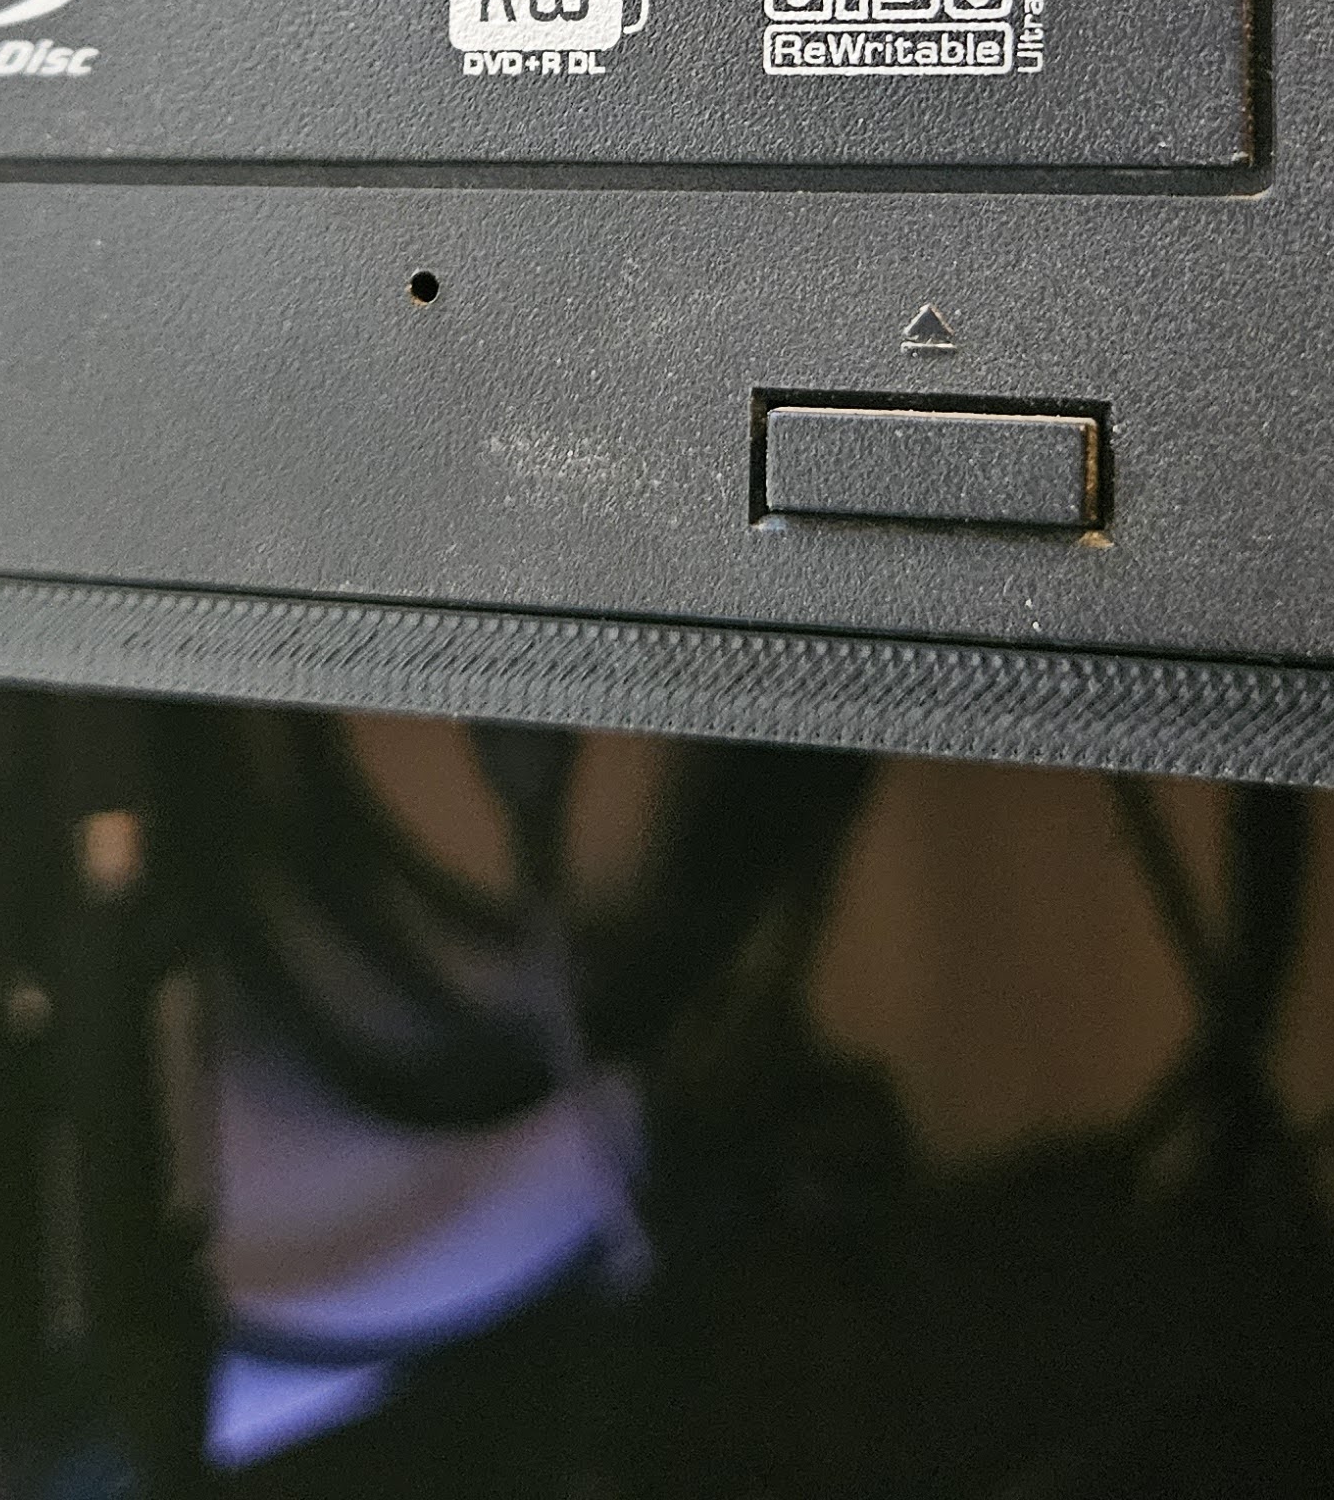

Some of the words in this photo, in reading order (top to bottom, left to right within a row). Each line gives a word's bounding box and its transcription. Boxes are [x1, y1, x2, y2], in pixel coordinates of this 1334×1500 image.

[463, 51, 563, 76] DVD+R
[568, 51, 606, 75] DL
[774, 33, 1001, 66] ReWritable
